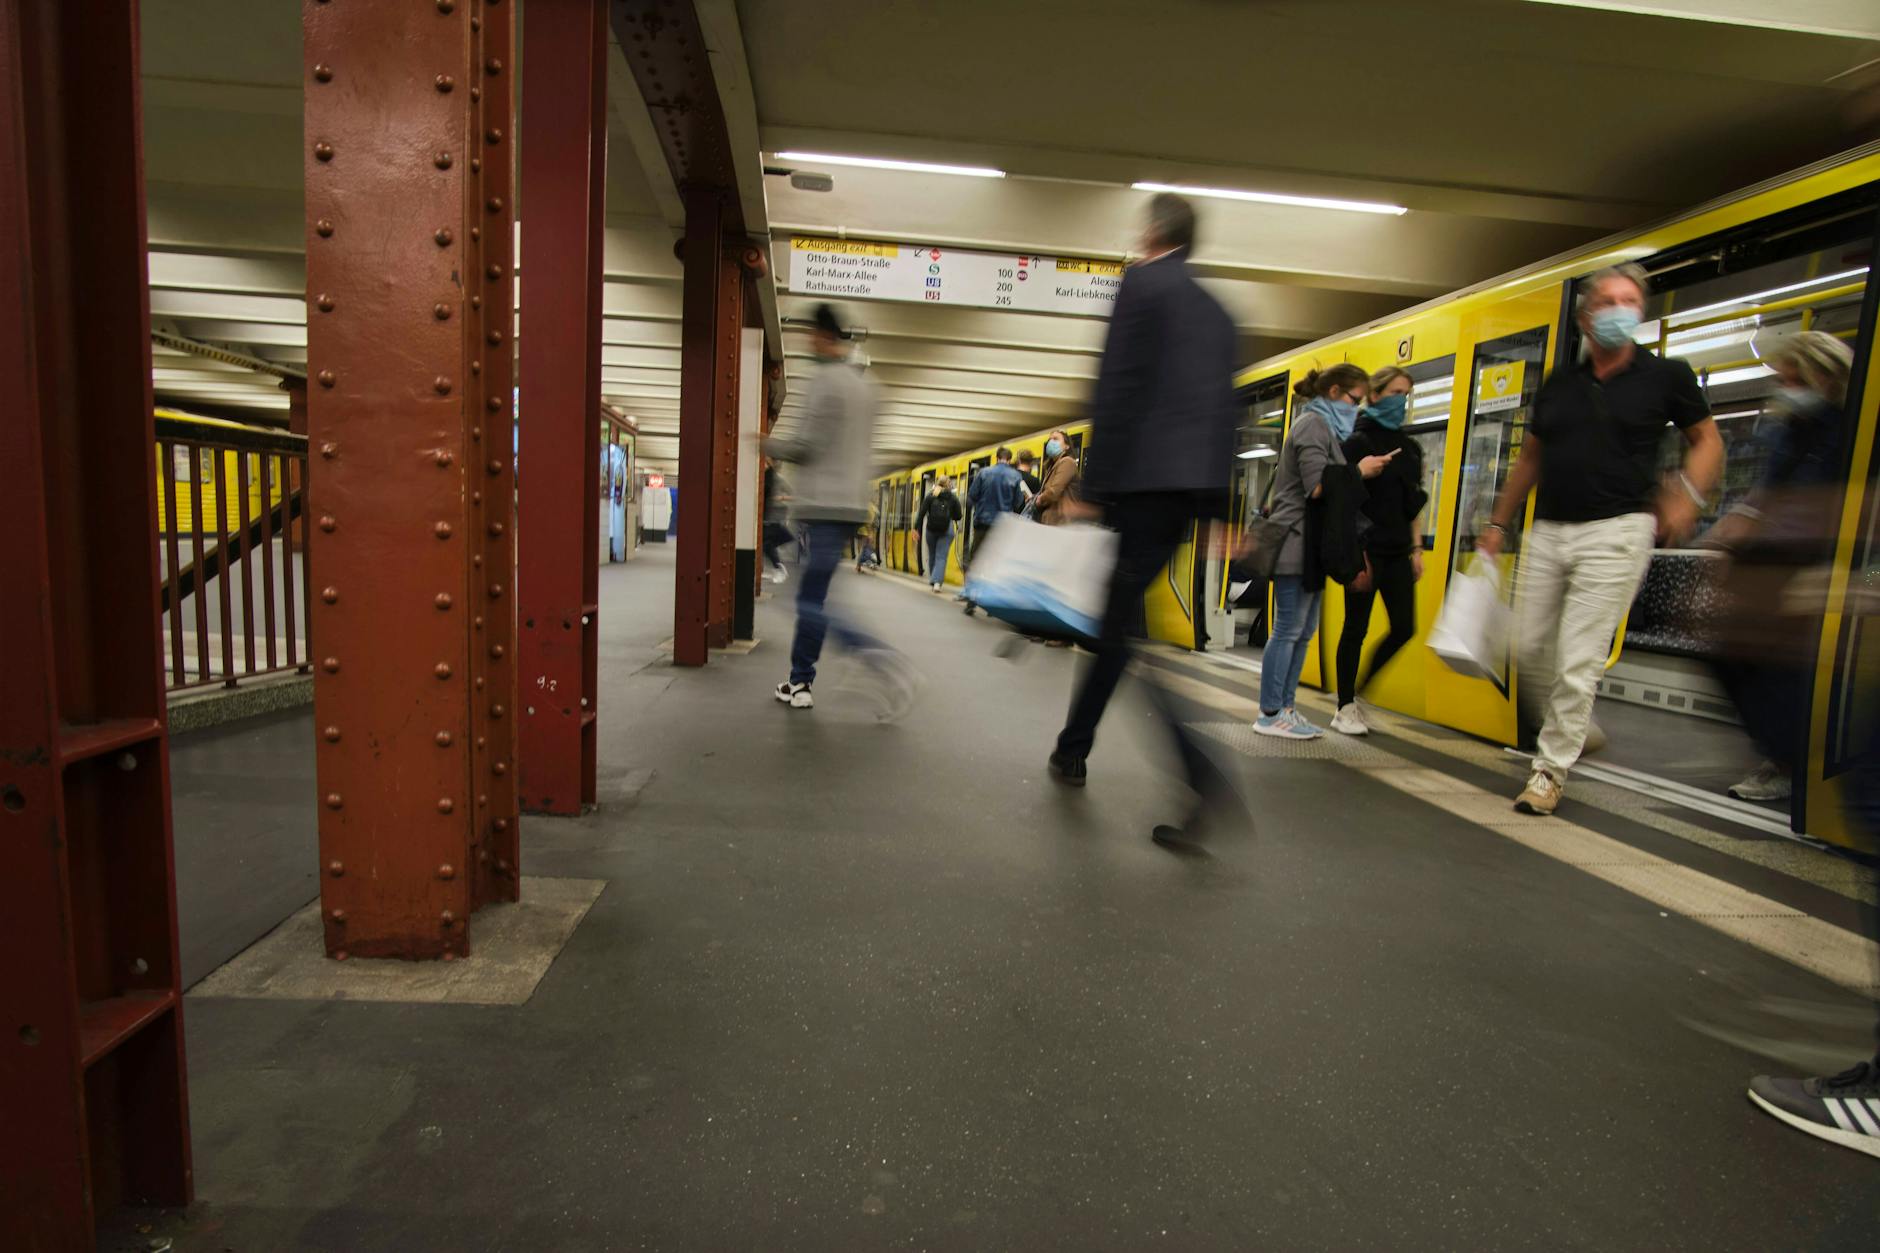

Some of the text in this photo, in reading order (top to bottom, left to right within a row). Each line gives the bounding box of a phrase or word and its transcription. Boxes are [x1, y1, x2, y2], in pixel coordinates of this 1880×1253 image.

[807, 240, 867, 254] Ausgang exit
[807, 253, 890, 268] Otto-Braun-Straße
[806, 266, 878, 282] Karl-Marx-Allee
[998, 268, 1014, 279] 100
[806, 280, 871, 293] Rathausstraße
[996, 282, 1014, 293] 200
[995, 296, 1012, 306] 245
